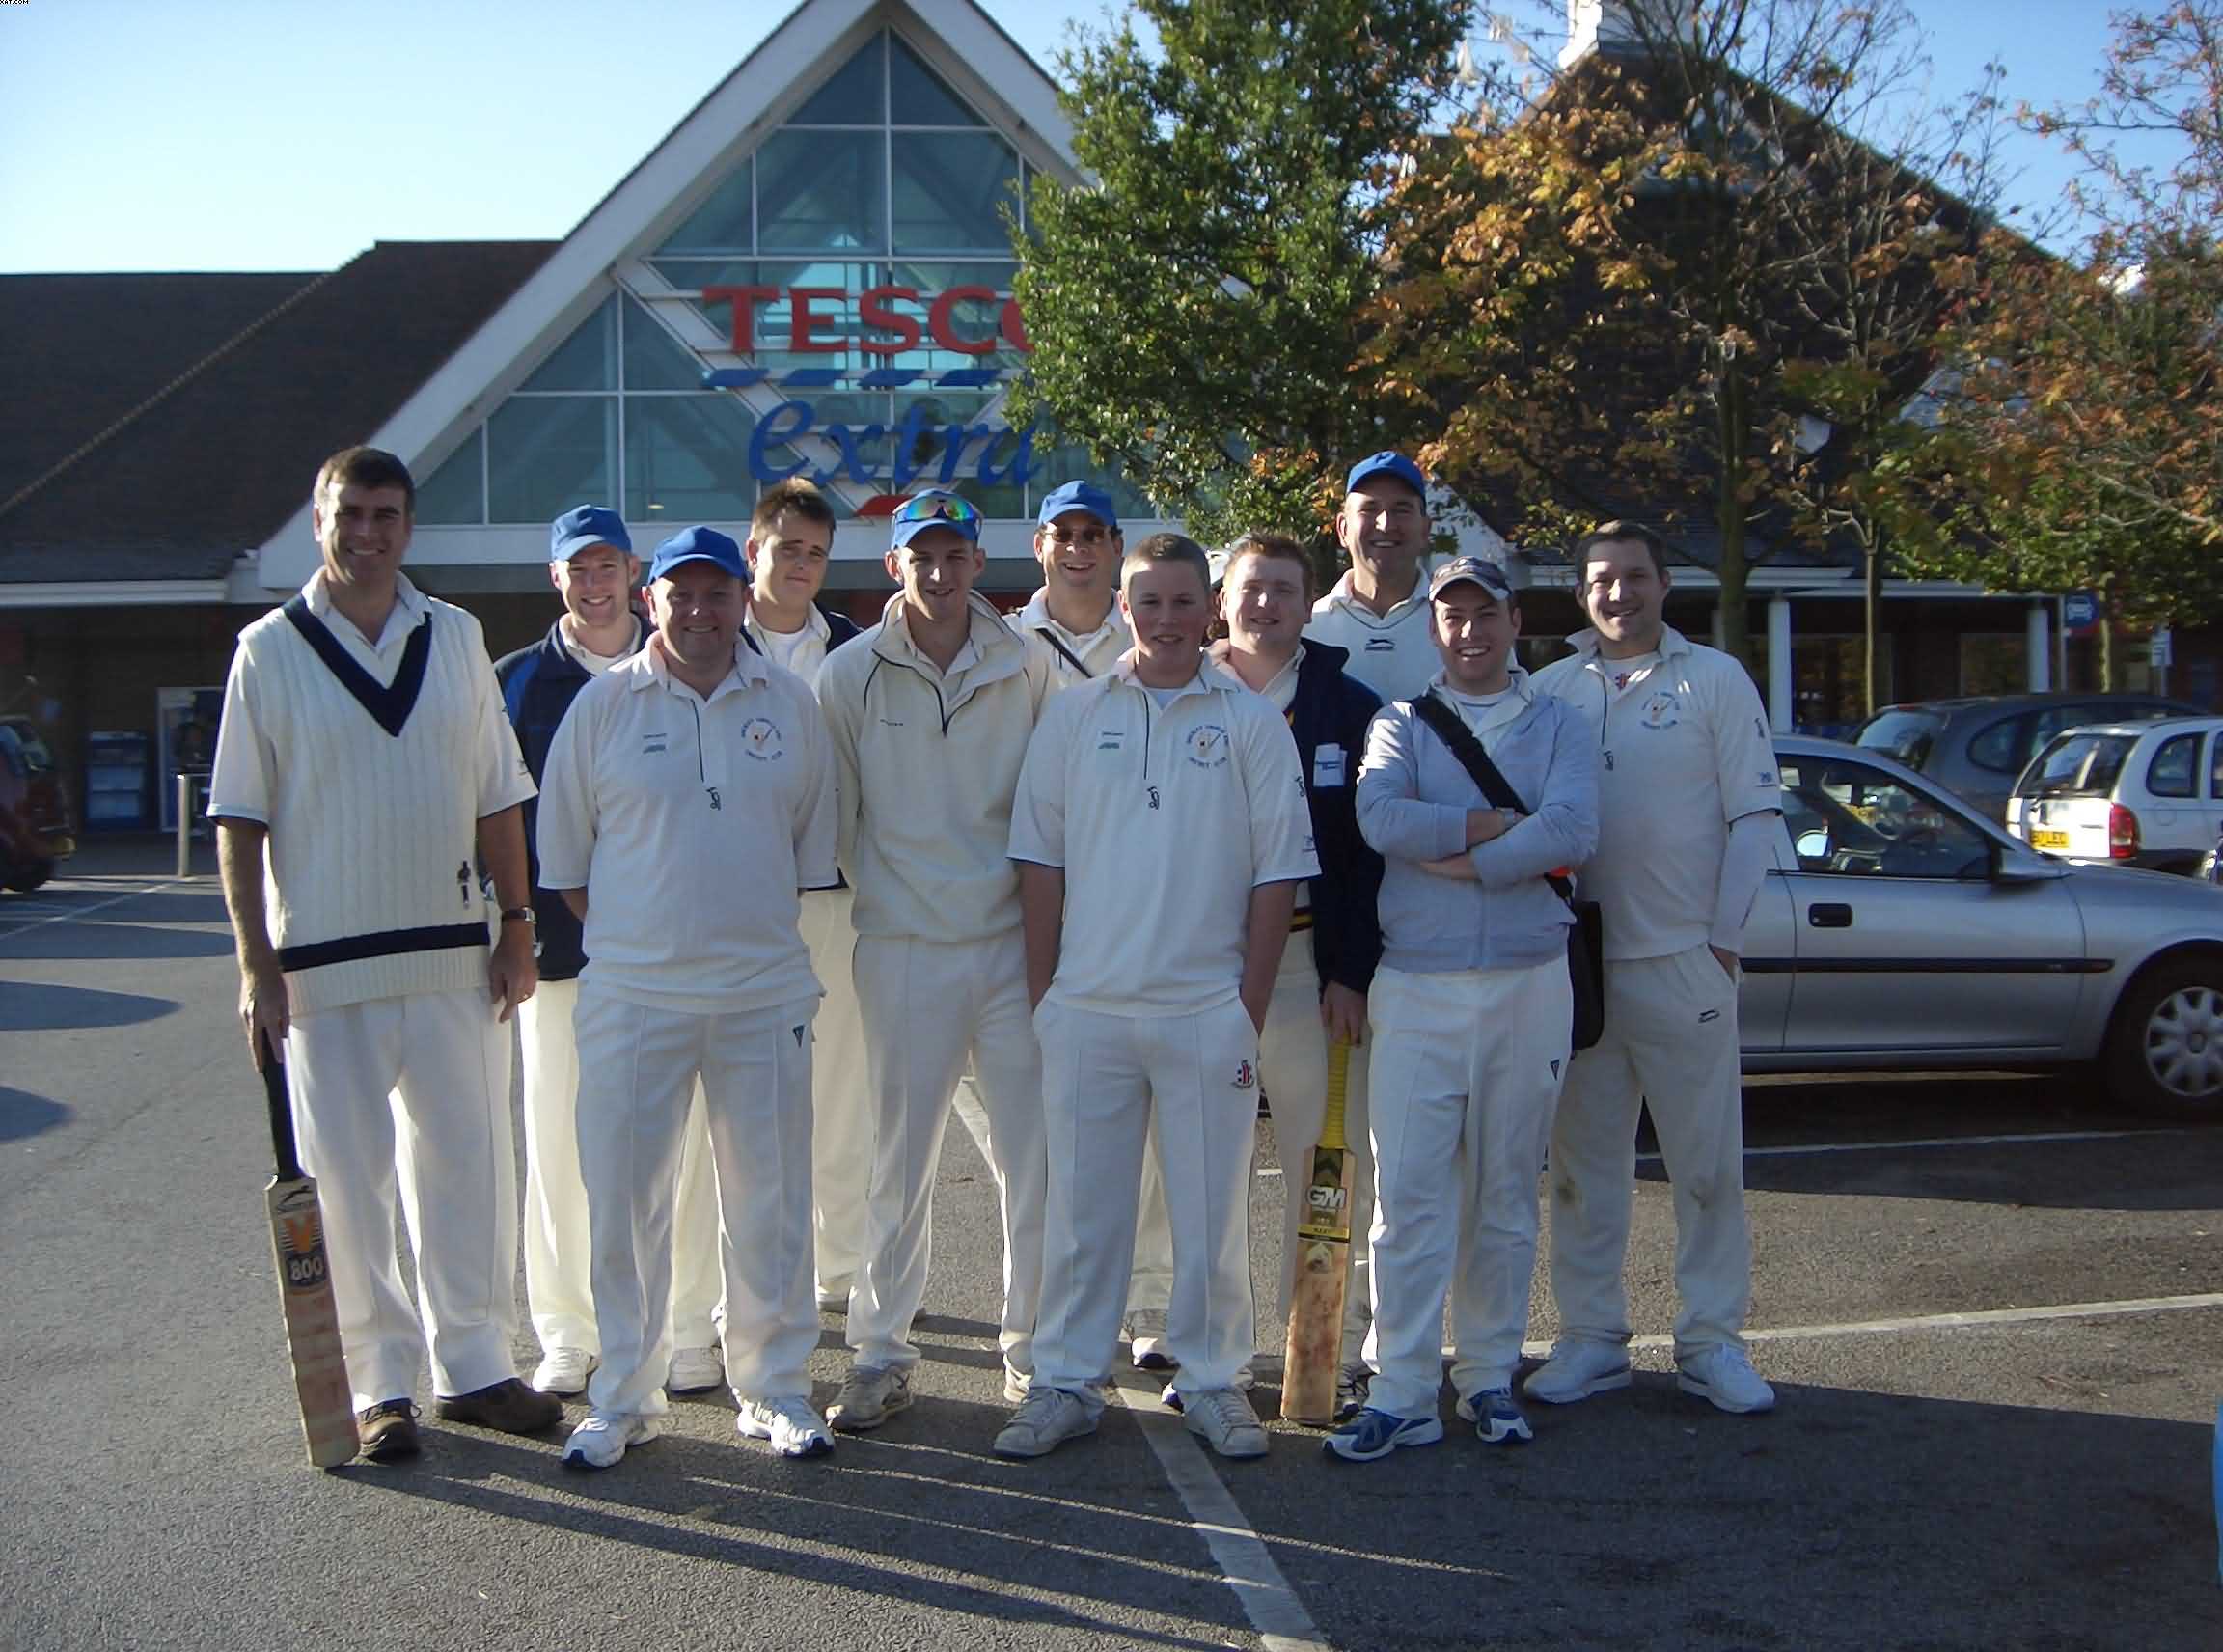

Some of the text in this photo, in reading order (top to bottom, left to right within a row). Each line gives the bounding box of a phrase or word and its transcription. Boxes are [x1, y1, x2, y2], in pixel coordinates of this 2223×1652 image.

[748, 400, 1043, 487] extra
[1304, 1186, 1347, 1208] GM
[291, 1257, 324, 1280] 800
